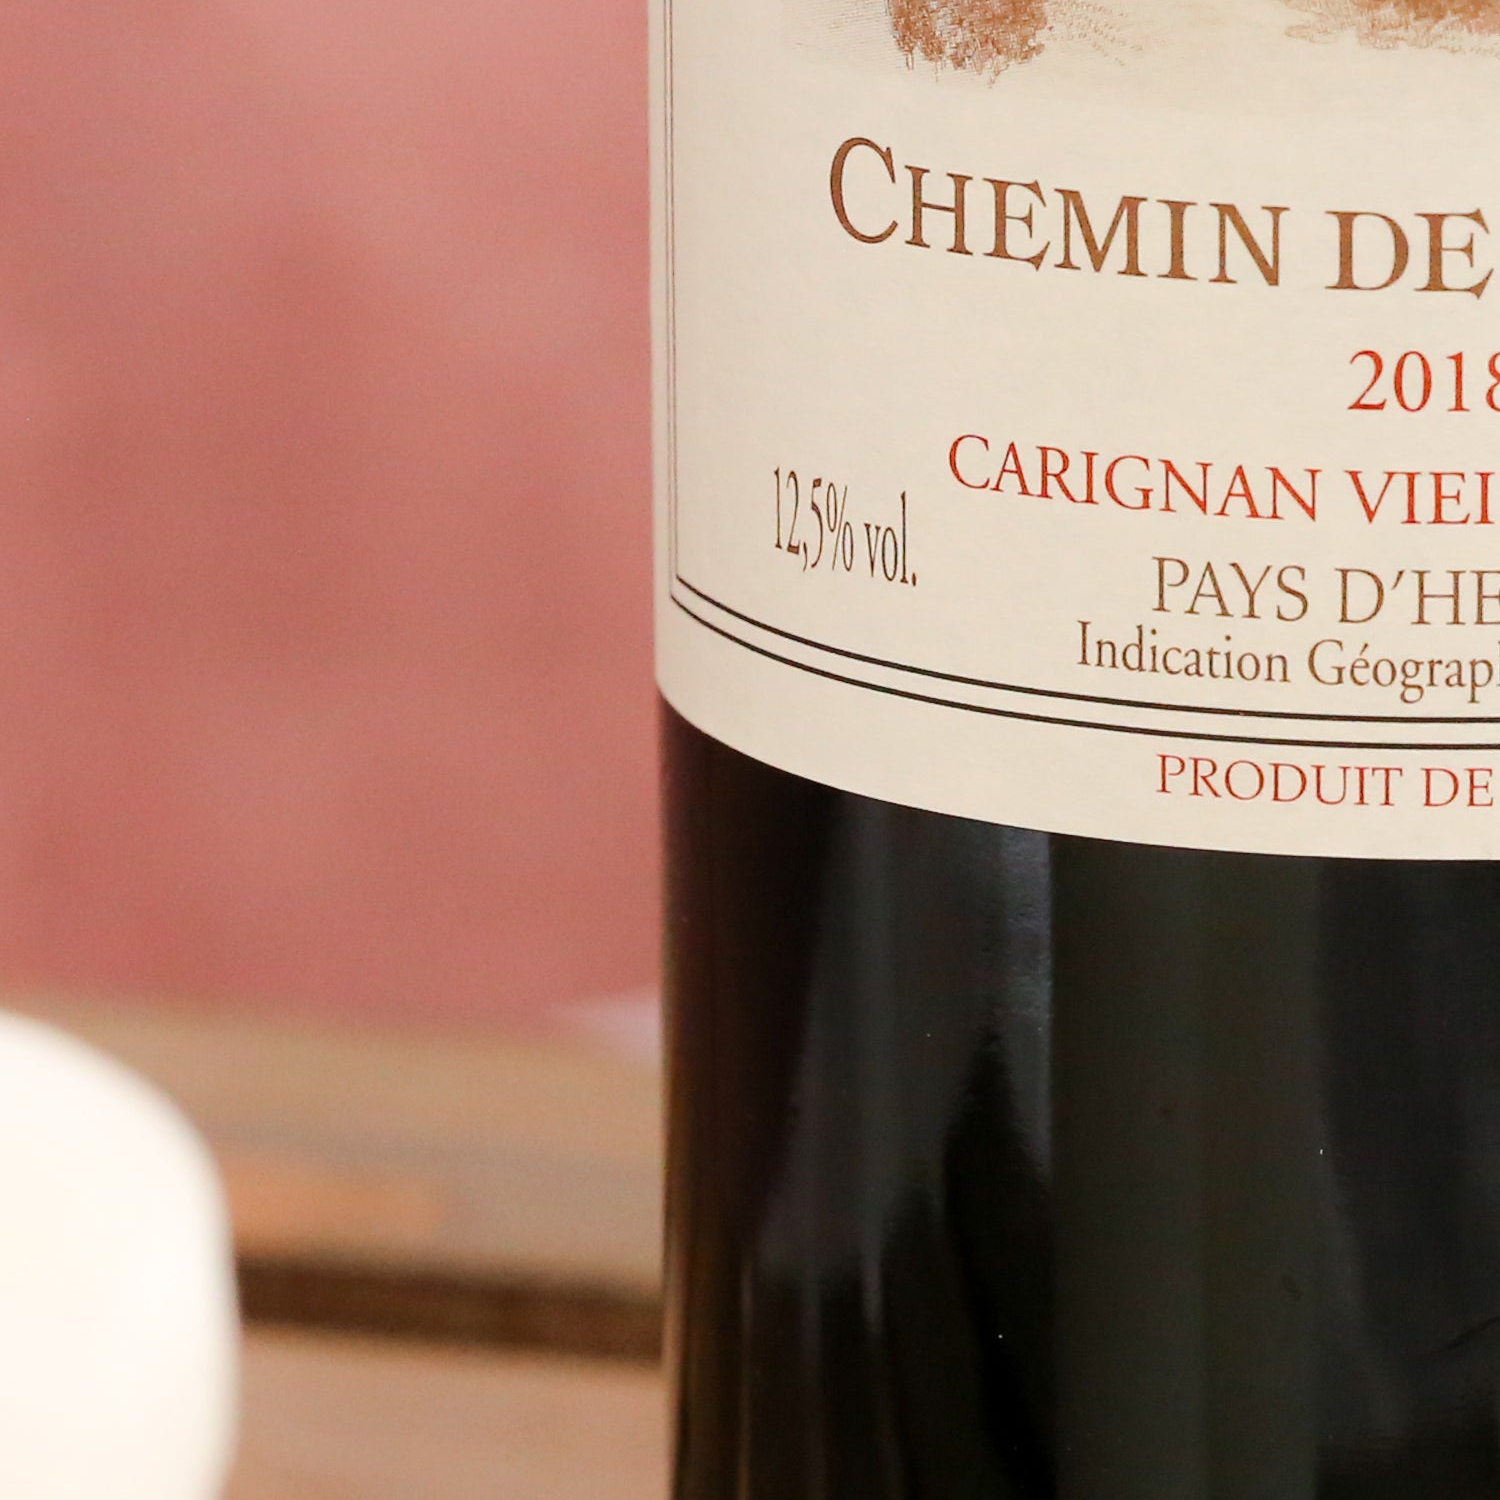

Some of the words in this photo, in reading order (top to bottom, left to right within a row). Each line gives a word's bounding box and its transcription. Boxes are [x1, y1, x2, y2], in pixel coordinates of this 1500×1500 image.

[829, 136, 1291, 287] CHEMIN
[1324, 208, 1494, 300] DE
[948, 434, 1322, 522] CARIGNAN
[773, 467, 854, 572] 12,5%
[863, 490, 917, 587] vol.
[1152, 556, 1309, 622] PAYS
[1077, 620, 1290, 683] Indication
[1157, 754, 1403, 807] PRODUIT
[1421, 767, 1494, 807] DE
